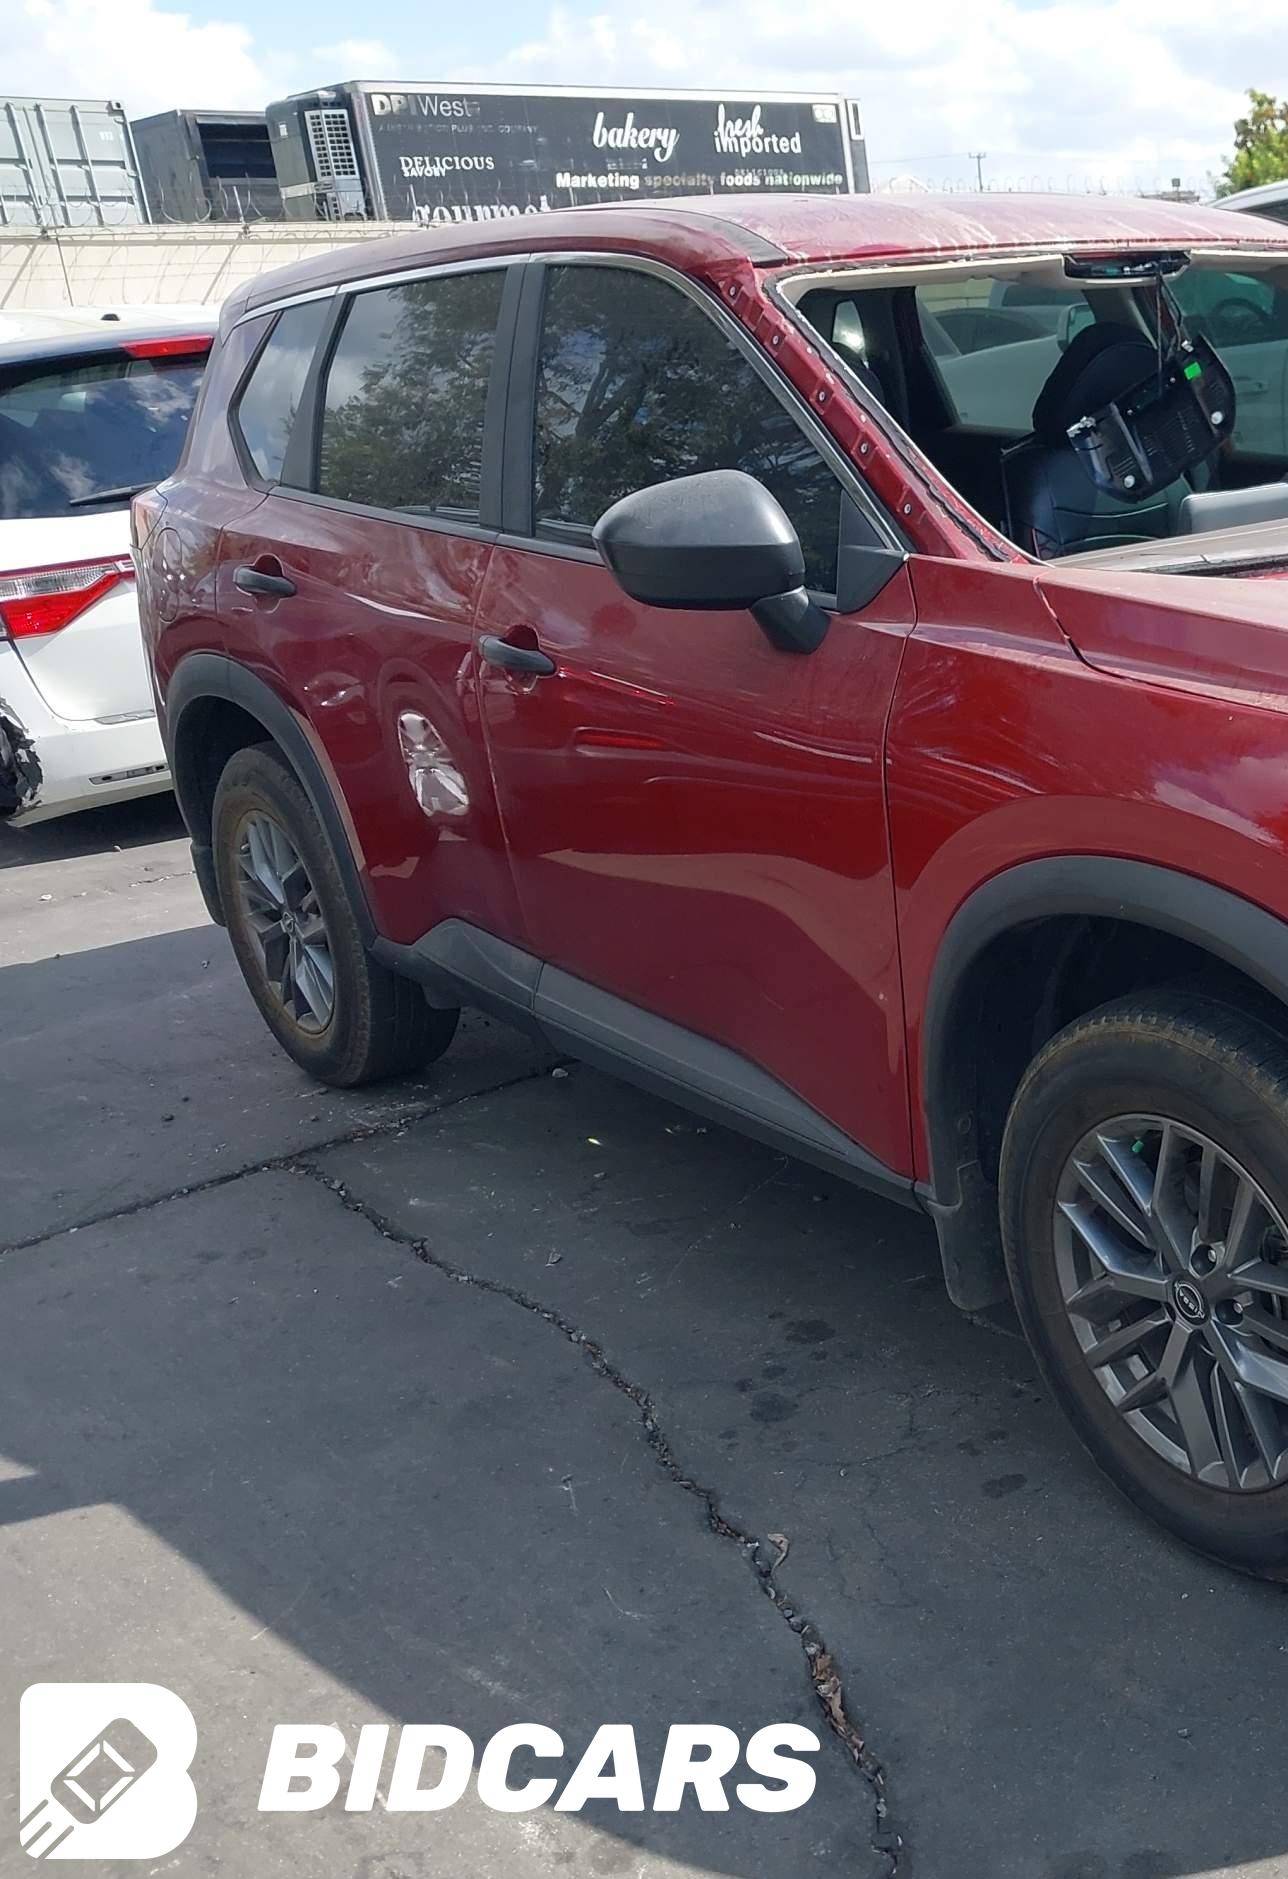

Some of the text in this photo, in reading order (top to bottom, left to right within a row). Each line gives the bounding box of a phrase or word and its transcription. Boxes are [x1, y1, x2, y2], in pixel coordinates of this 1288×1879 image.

[417, 95, 472, 117] West
[593, 111, 680, 162] bakery
[714, 131, 802, 157] imported
[399, 156, 495, 171] DELICIOUS
[556, 172, 843, 190] Marketing specialty foods nationwide
